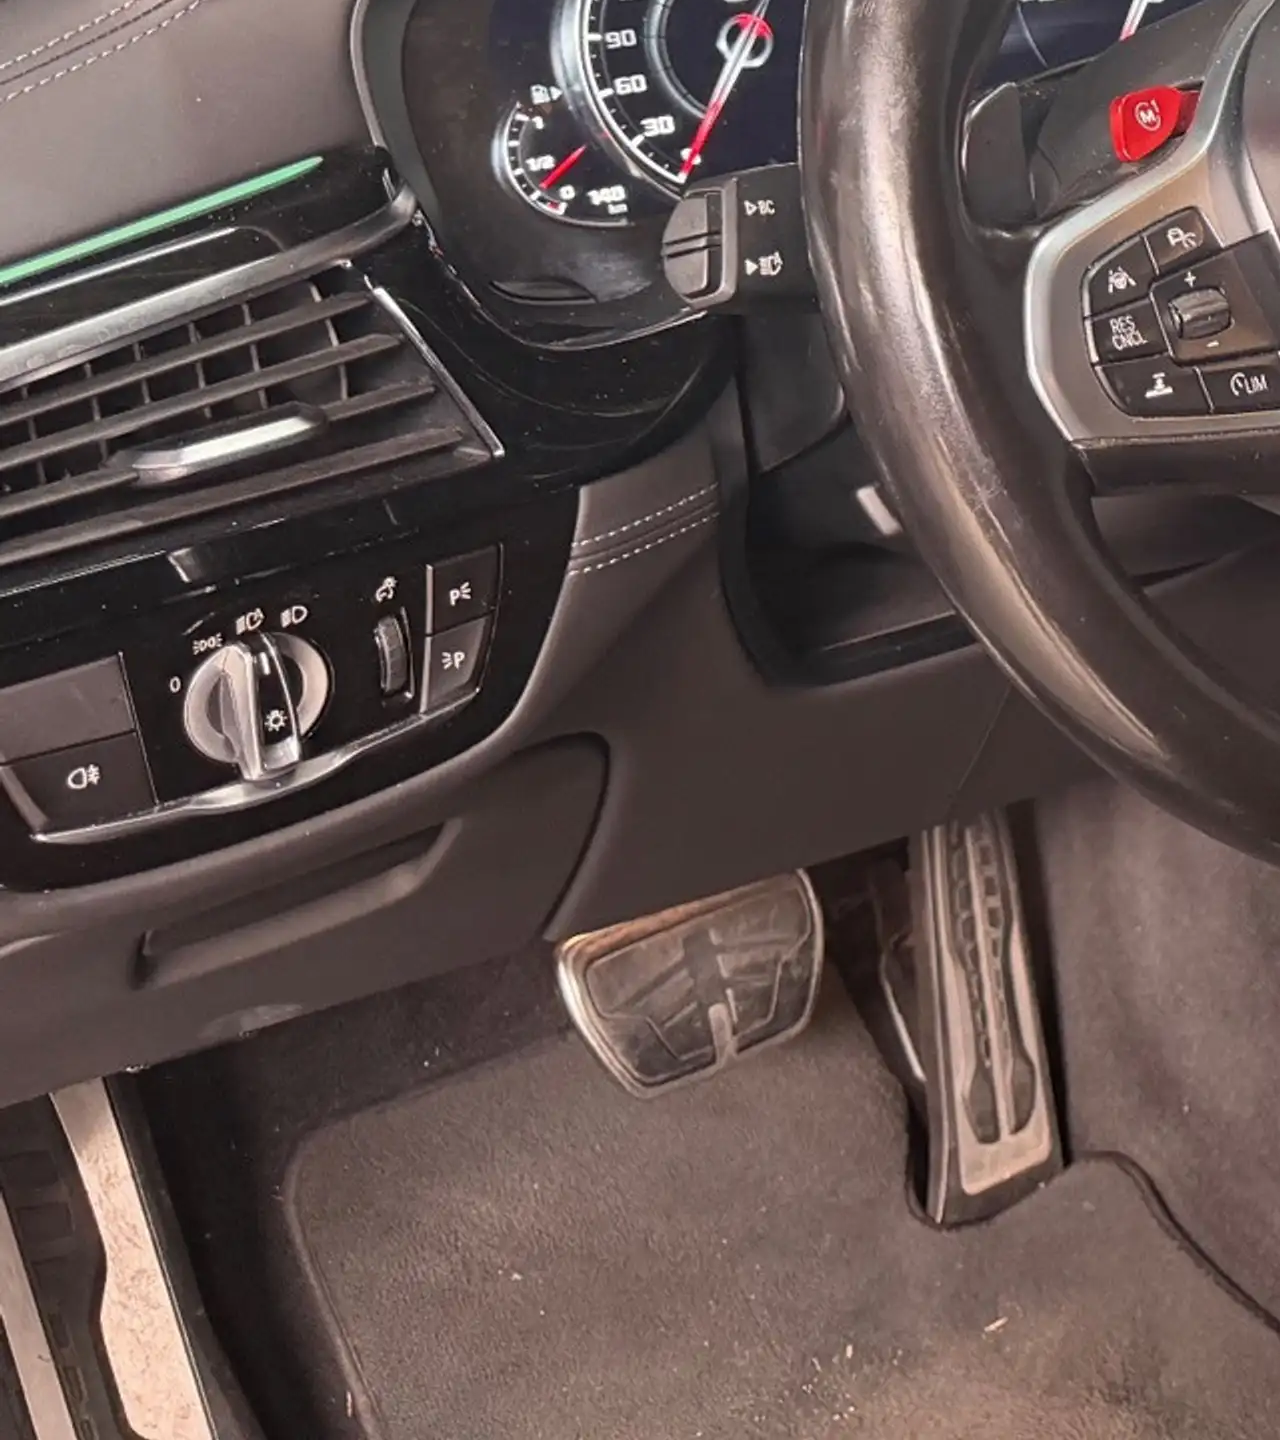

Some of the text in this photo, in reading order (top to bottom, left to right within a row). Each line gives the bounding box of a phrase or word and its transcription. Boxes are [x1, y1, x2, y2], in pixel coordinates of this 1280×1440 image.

[605, 29, 637, 49] 90
[614, 74, 648, 95] 60
[640, 115, 676, 137] 30
[1109, 314, 1136, 333] RES
[449, 588, 460, 606] P
[453, 651, 466, 670] P
